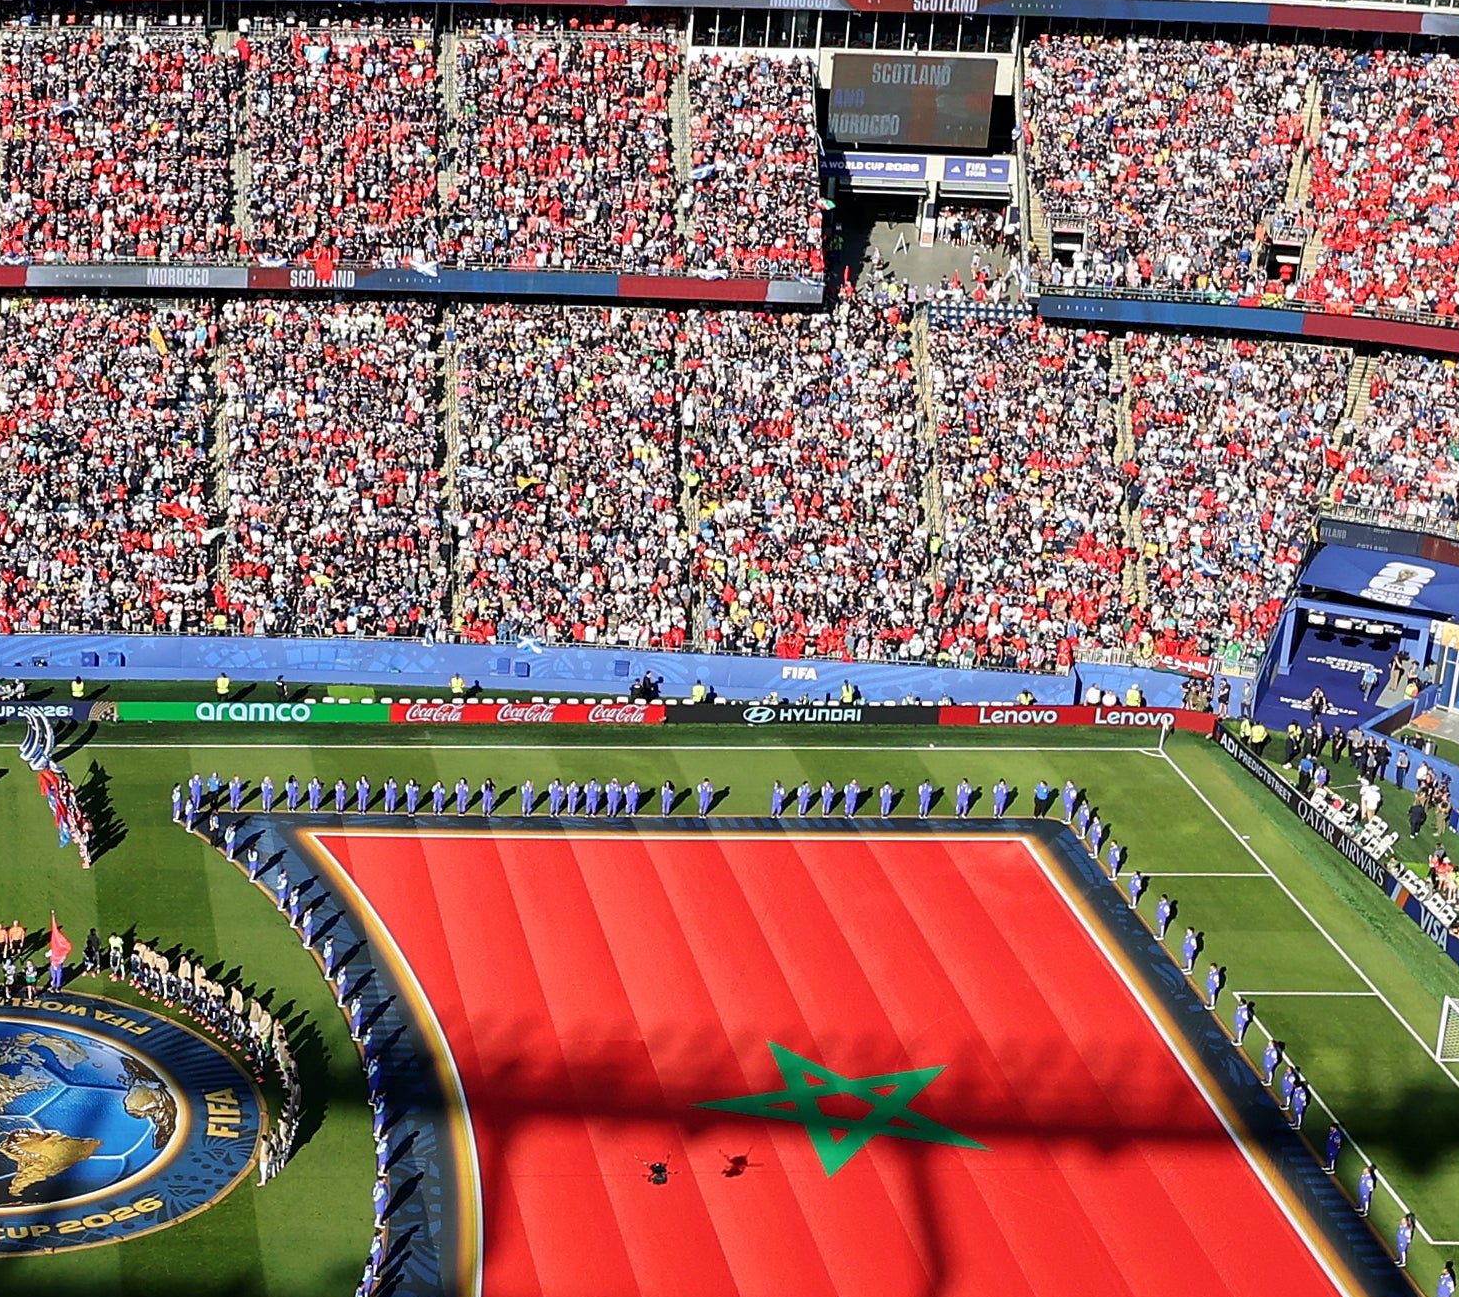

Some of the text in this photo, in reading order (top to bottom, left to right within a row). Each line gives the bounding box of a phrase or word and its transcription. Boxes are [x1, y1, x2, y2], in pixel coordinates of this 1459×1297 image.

[872, 62, 952, 86] SCOTLAND
[828, 161, 920, 172] WORLD CUP 2026
[965, 162, 987, 171] FIFA
[146, 268, 210, 286] MOROCCO
[782, 665, 818, 681] FIFA
[195, 701, 311, 722] aramco
[779, 707, 862, 722] HYUNDAI
[978, 699, 1058, 724] Lenovo
[1095, 700, 1175, 727] Lenovo
[1219, 732, 1384, 887] ADI PREDICTSTREET QATAR AIRWAYS
[1419, 904, 1448, 952] VISA
[113, 1010, 153, 1036] FIFA
[206, 1087, 240, 1140] FIFA
[57, 1196, 165, 1235] 2026
